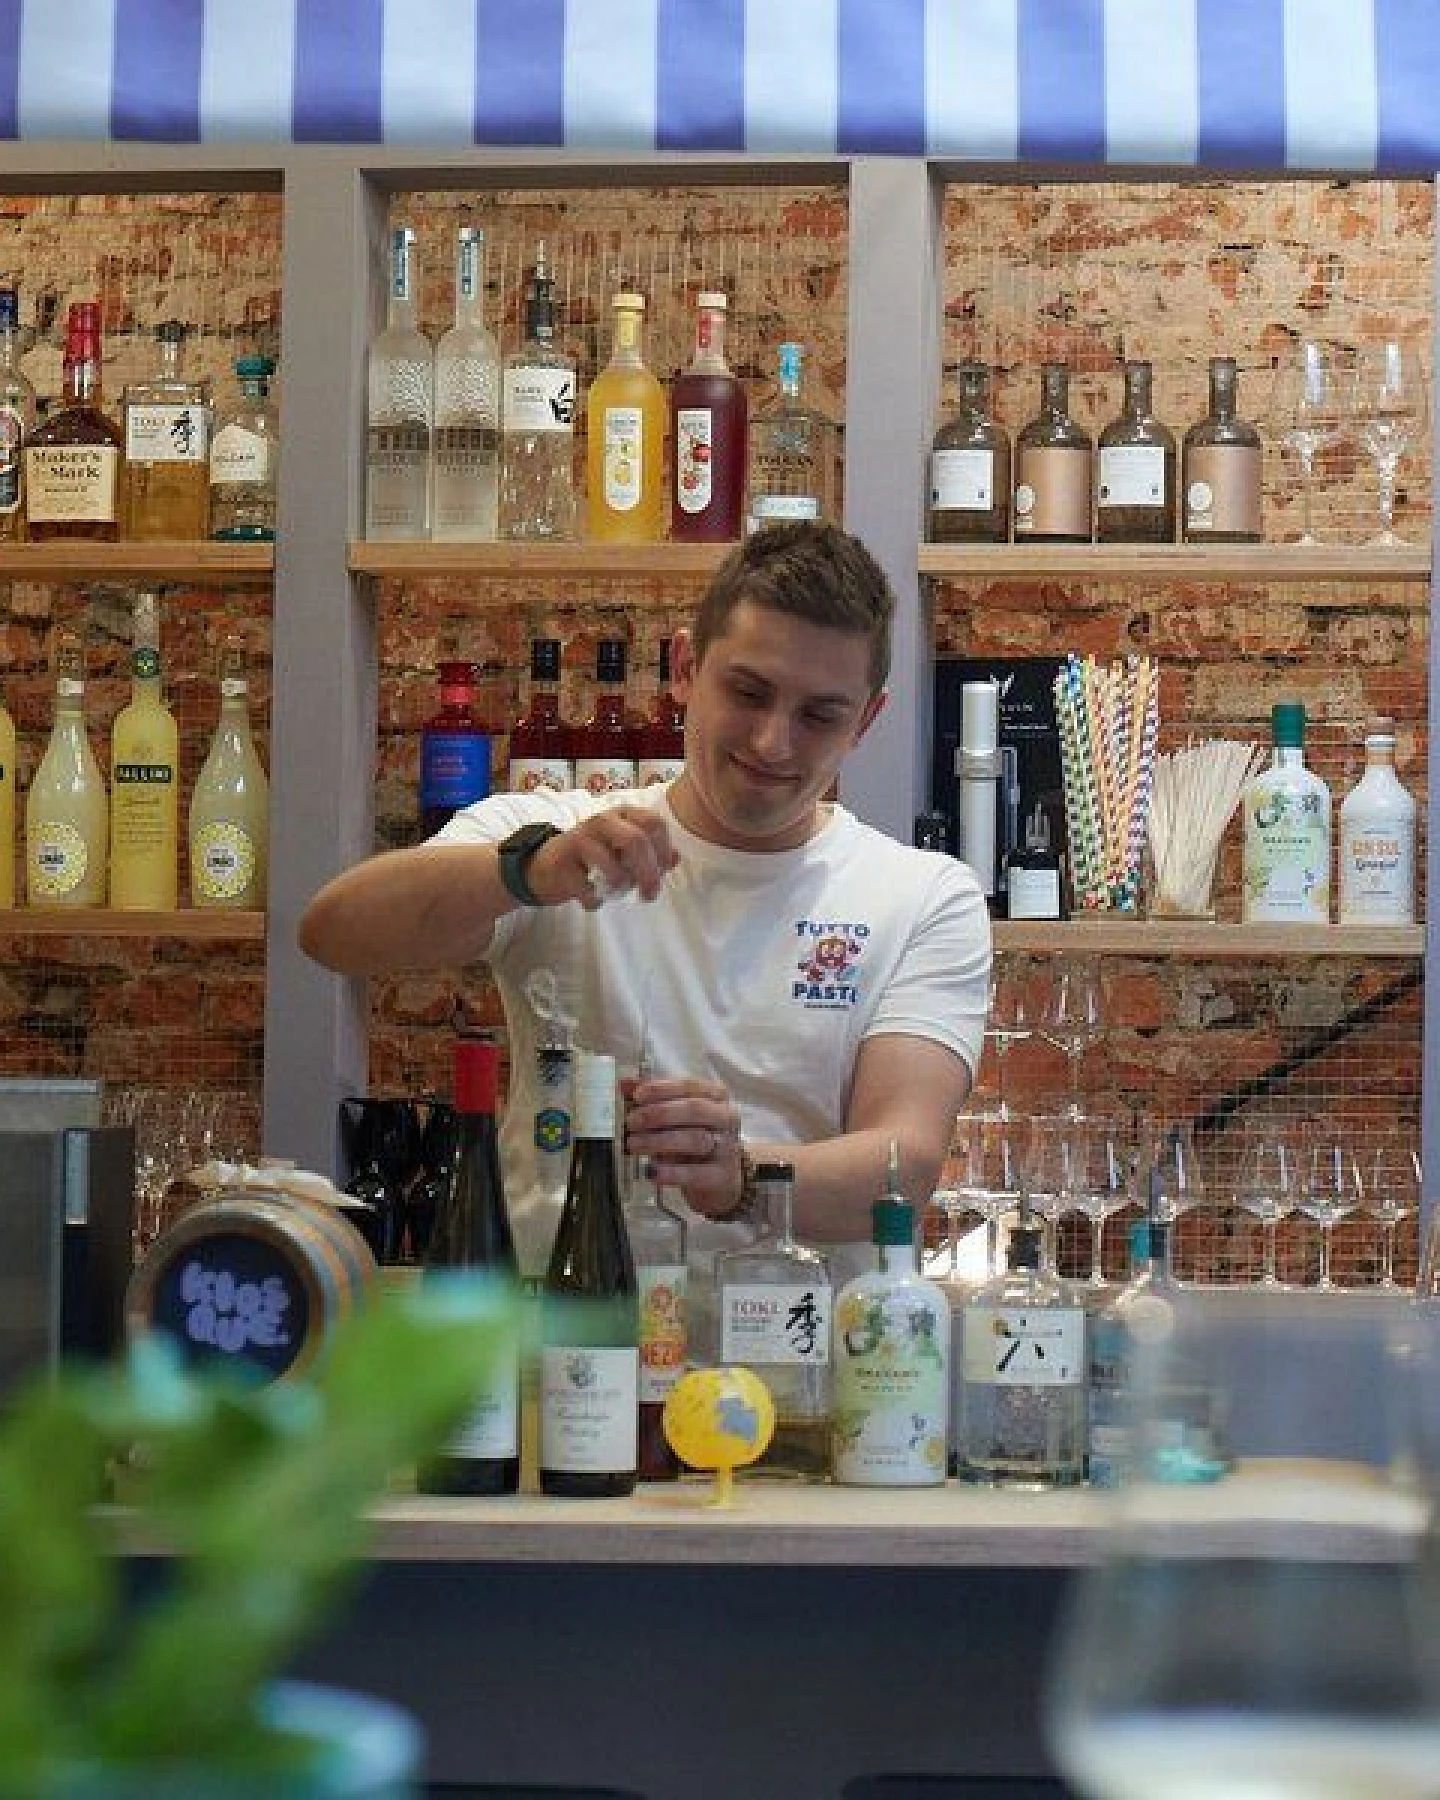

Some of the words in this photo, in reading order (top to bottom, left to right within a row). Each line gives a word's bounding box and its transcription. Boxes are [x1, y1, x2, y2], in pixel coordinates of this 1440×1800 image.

[50, 464, 100, 479] Mark
[795, 920, 870, 937] TUTTO
[731, 1299, 778, 1314] TOKI
